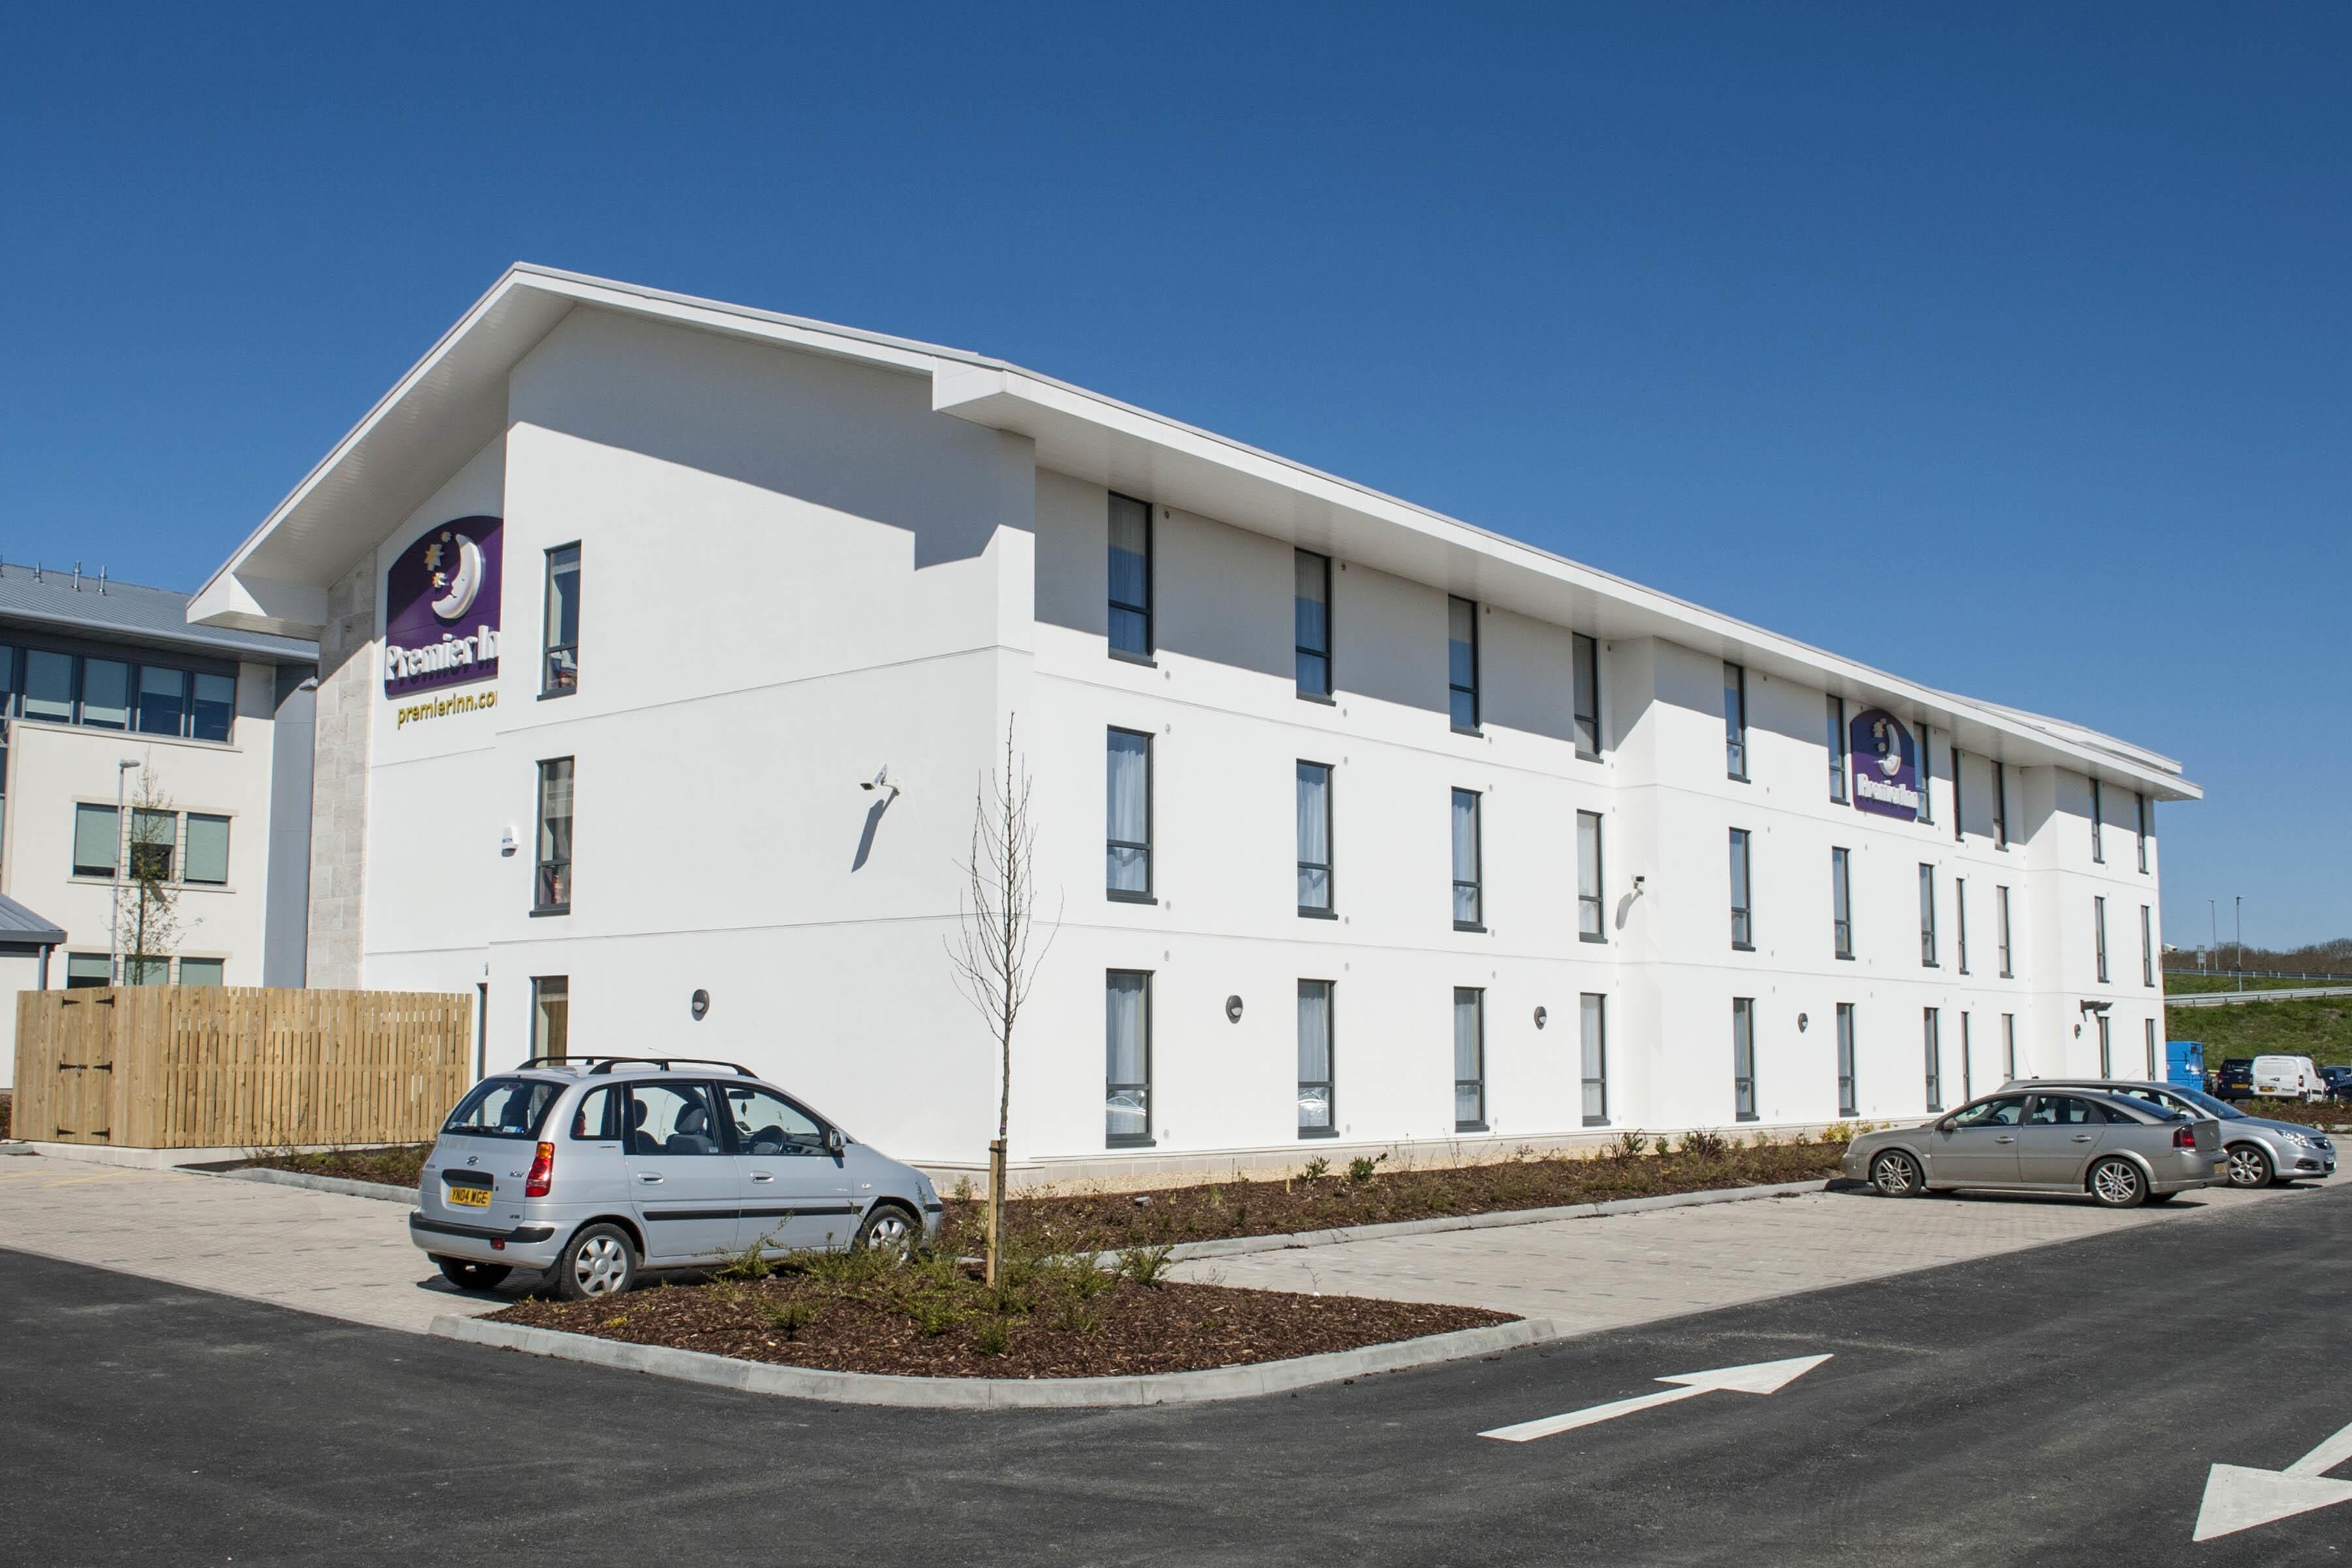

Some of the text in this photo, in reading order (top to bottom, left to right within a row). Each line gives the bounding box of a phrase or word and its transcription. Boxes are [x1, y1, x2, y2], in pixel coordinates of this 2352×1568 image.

[385, 625, 500, 680] Premier In
[398, 691, 498, 730] premierinn.co
